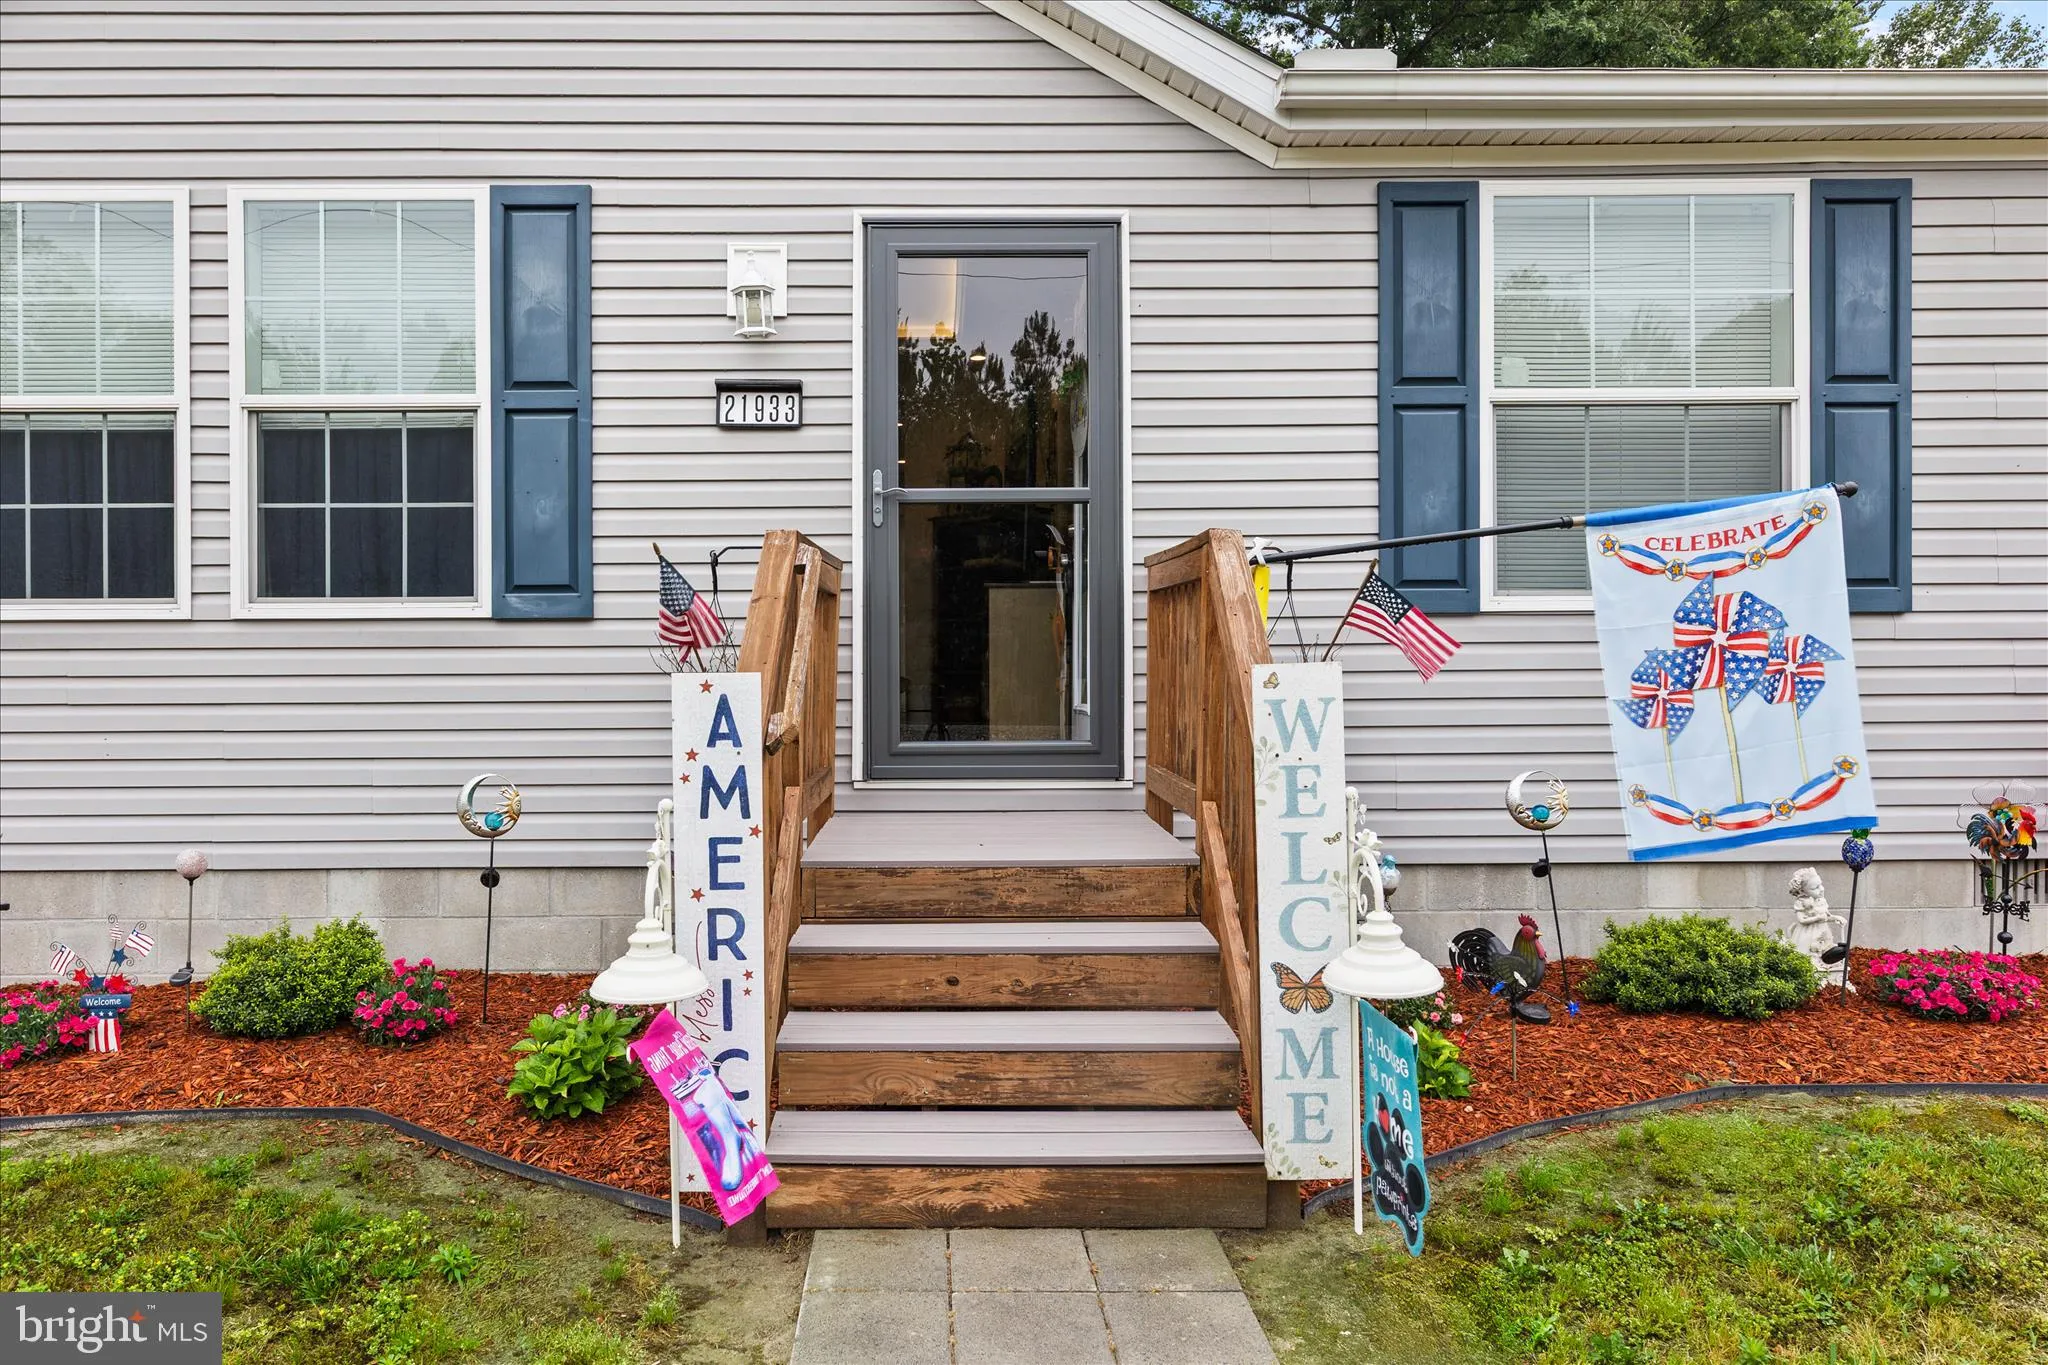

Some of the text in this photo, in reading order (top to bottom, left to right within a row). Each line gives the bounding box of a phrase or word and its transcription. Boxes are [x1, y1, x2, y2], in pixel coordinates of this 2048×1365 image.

[725, 394, 796, 423] 21933
[1644, 514, 1787, 553] CELEBRATE
[699, 692, 752, 1102] AMERIC
[1264, 696, 1341, 1145] WELCME
[85, 996, 122, 1007] Welcome
[1366, 1026, 1375, 1046] A
[1402, 1088, 1413, 1113] a
[1372, 1093, 1414, 1161] Hme
